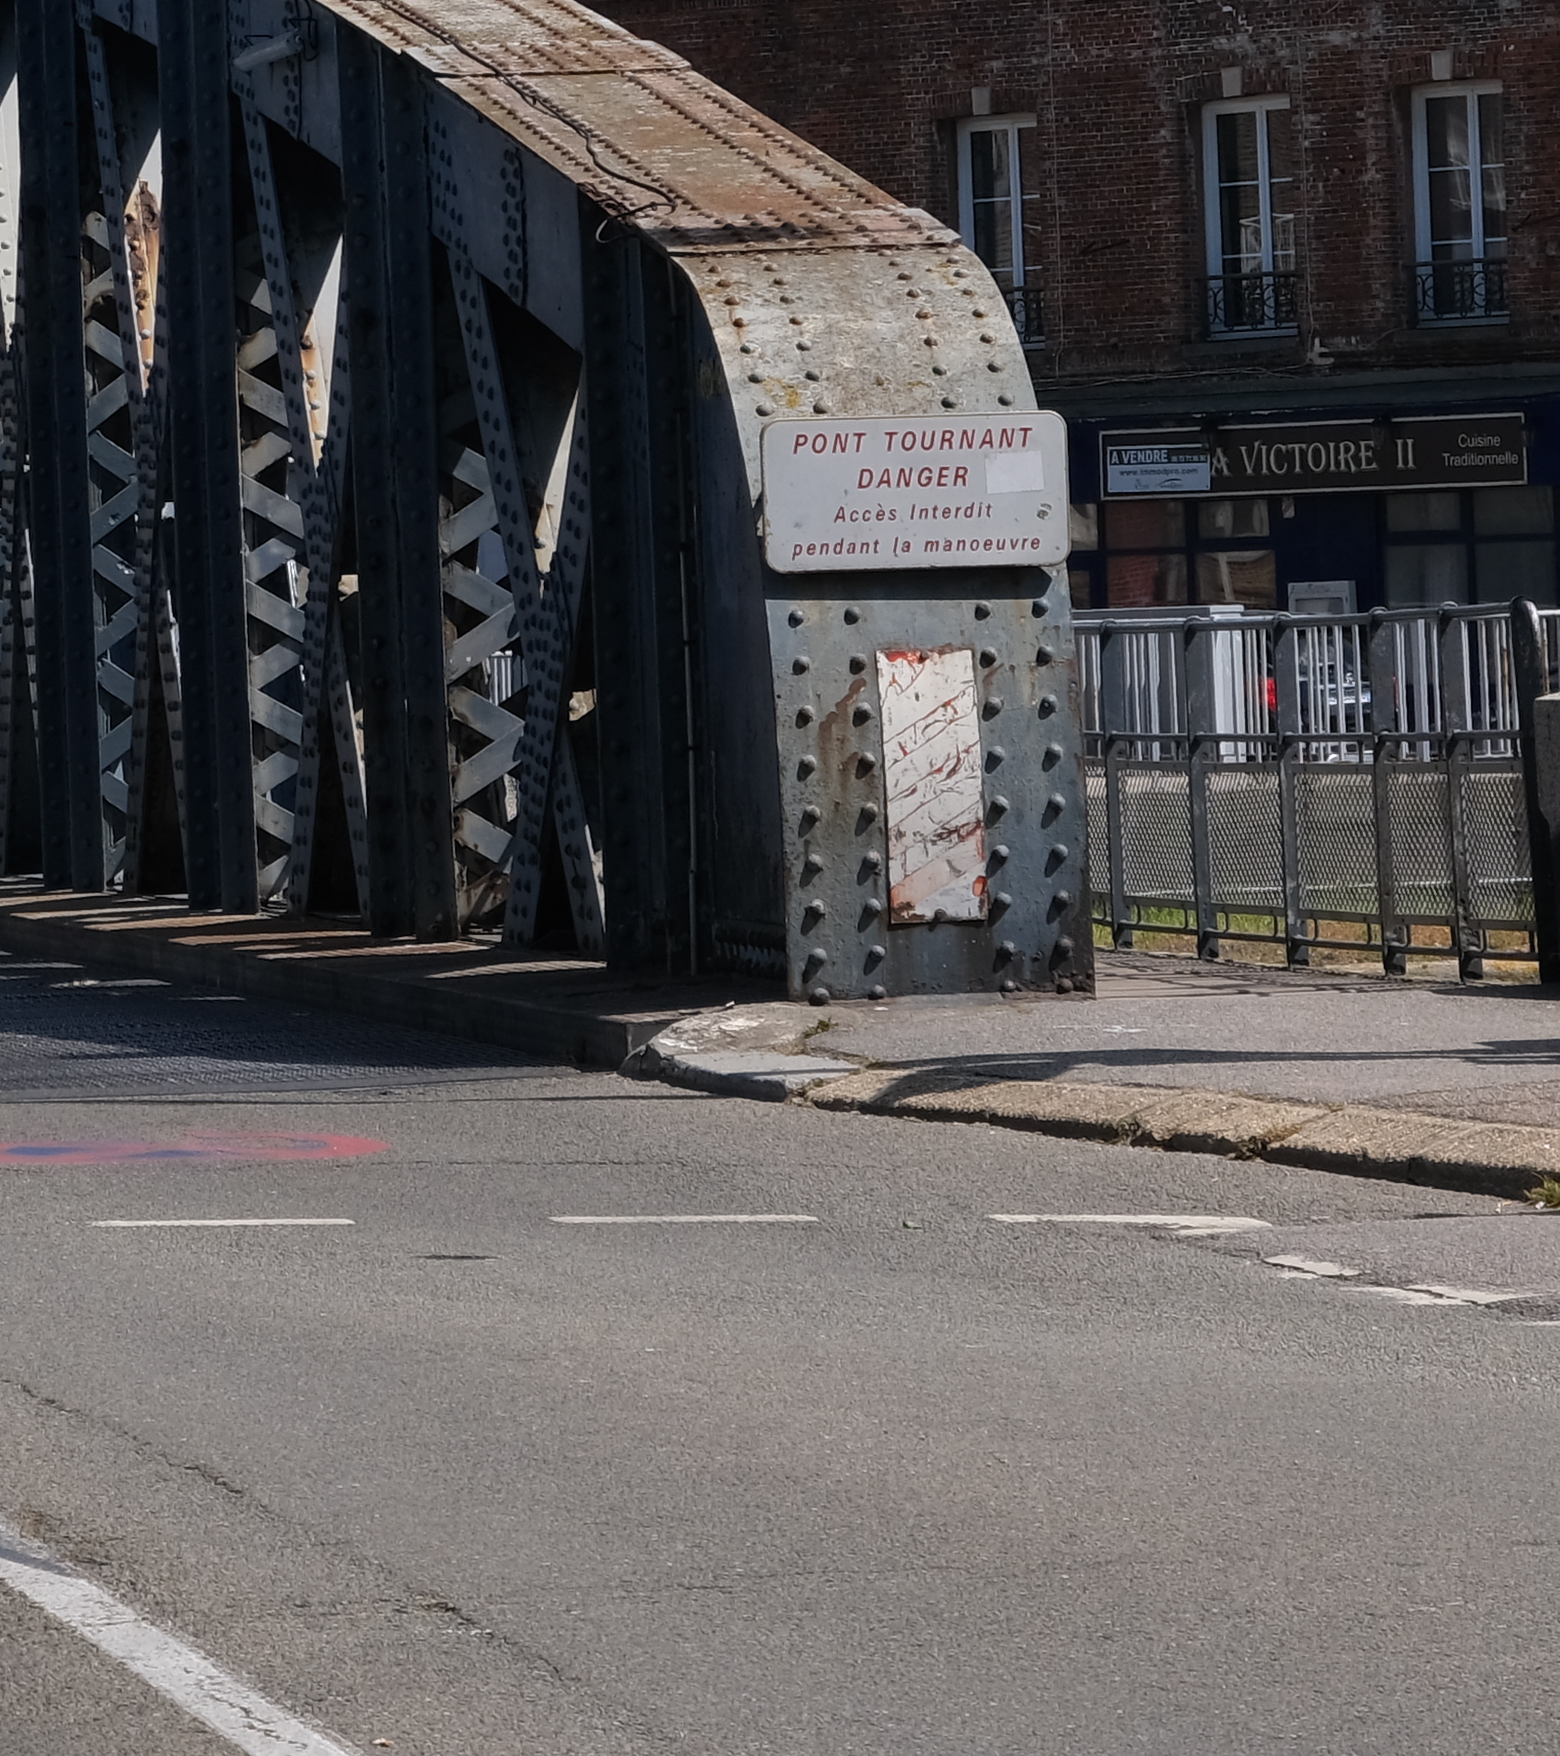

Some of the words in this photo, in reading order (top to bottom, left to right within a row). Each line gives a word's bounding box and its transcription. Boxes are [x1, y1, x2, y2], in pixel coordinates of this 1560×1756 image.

[792, 432, 867, 454] PONT
[884, 427, 1033, 452] TOURNANT
[1457, 433, 1502, 449] Cuisine
[1111, 450, 1120, 464] A
[1121, 449, 1169, 464] VENDRE
[1240, 439, 1378, 476] VICTOIRE
[1396, 438, 1416, 471] II
[1442, 451, 1519, 468] Traditionnelle
[857, 466, 970, 489] DANGER
[833, 503, 898, 524] Accès
[909, 501, 993, 521] Interdit
[791, 537, 880, 561] pendant
[892, 536, 911, 557] la
[923, 536, 1041, 555] manoeuvre
